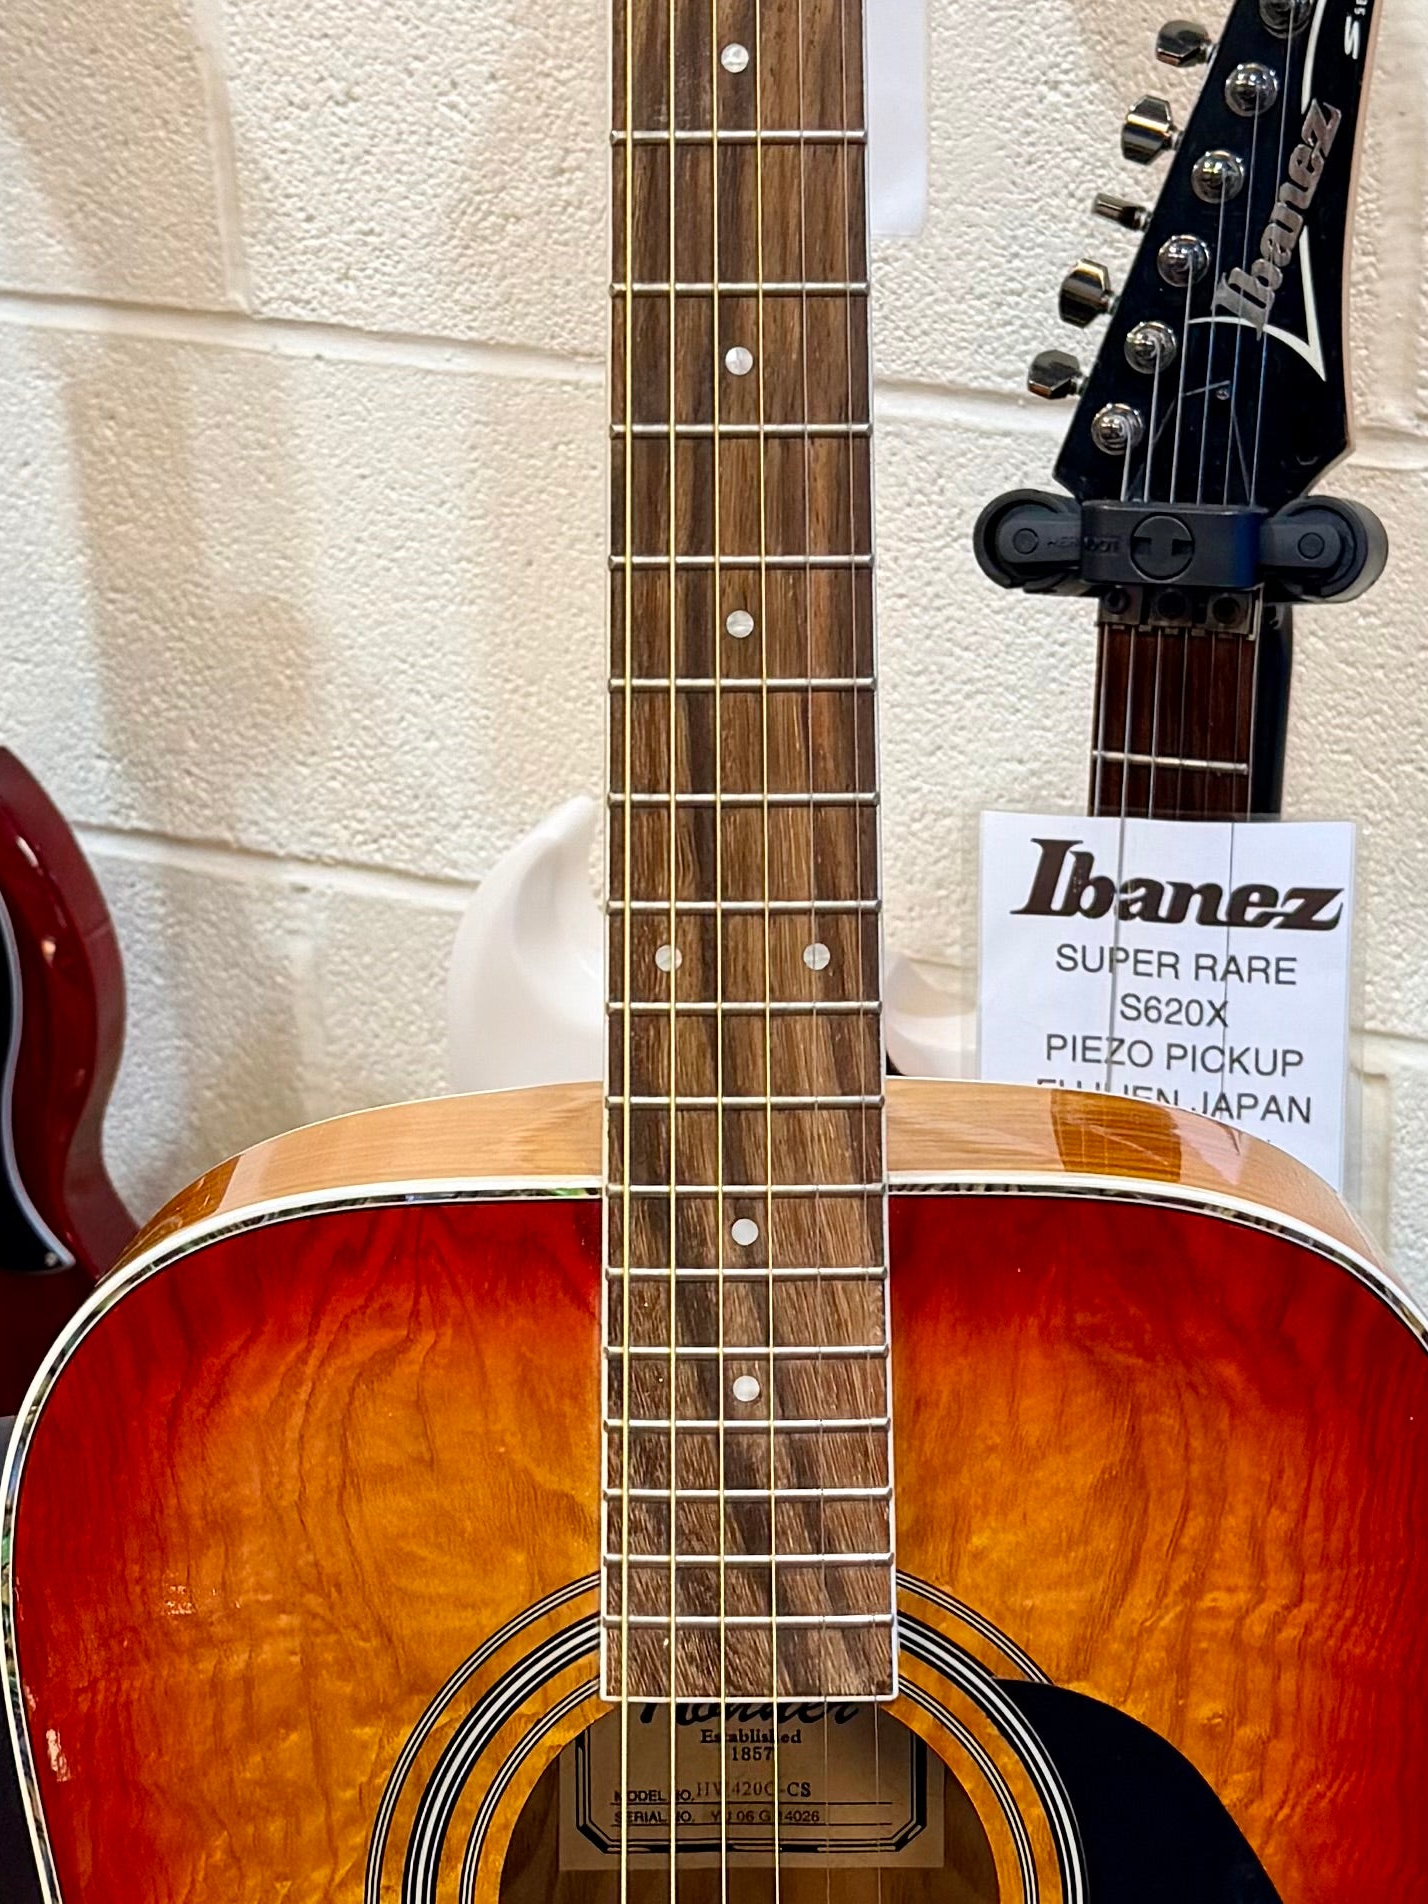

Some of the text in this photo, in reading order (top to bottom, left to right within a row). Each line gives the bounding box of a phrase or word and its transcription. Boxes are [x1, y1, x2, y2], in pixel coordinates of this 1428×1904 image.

[1210, 97, 1343, 342] Ibanez
[1010, 837, 1344, 931] Ibanez
[1056, 943, 1298, 986] SUPER RARE
[1119, 992, 1229, 1028] S620X
[1045, 1033, 1304, 1078] PIEZO PICKUP
[1191, 1090, 1312, 1124] JAPAN
[731, 1746, 774, 1761] 1857
